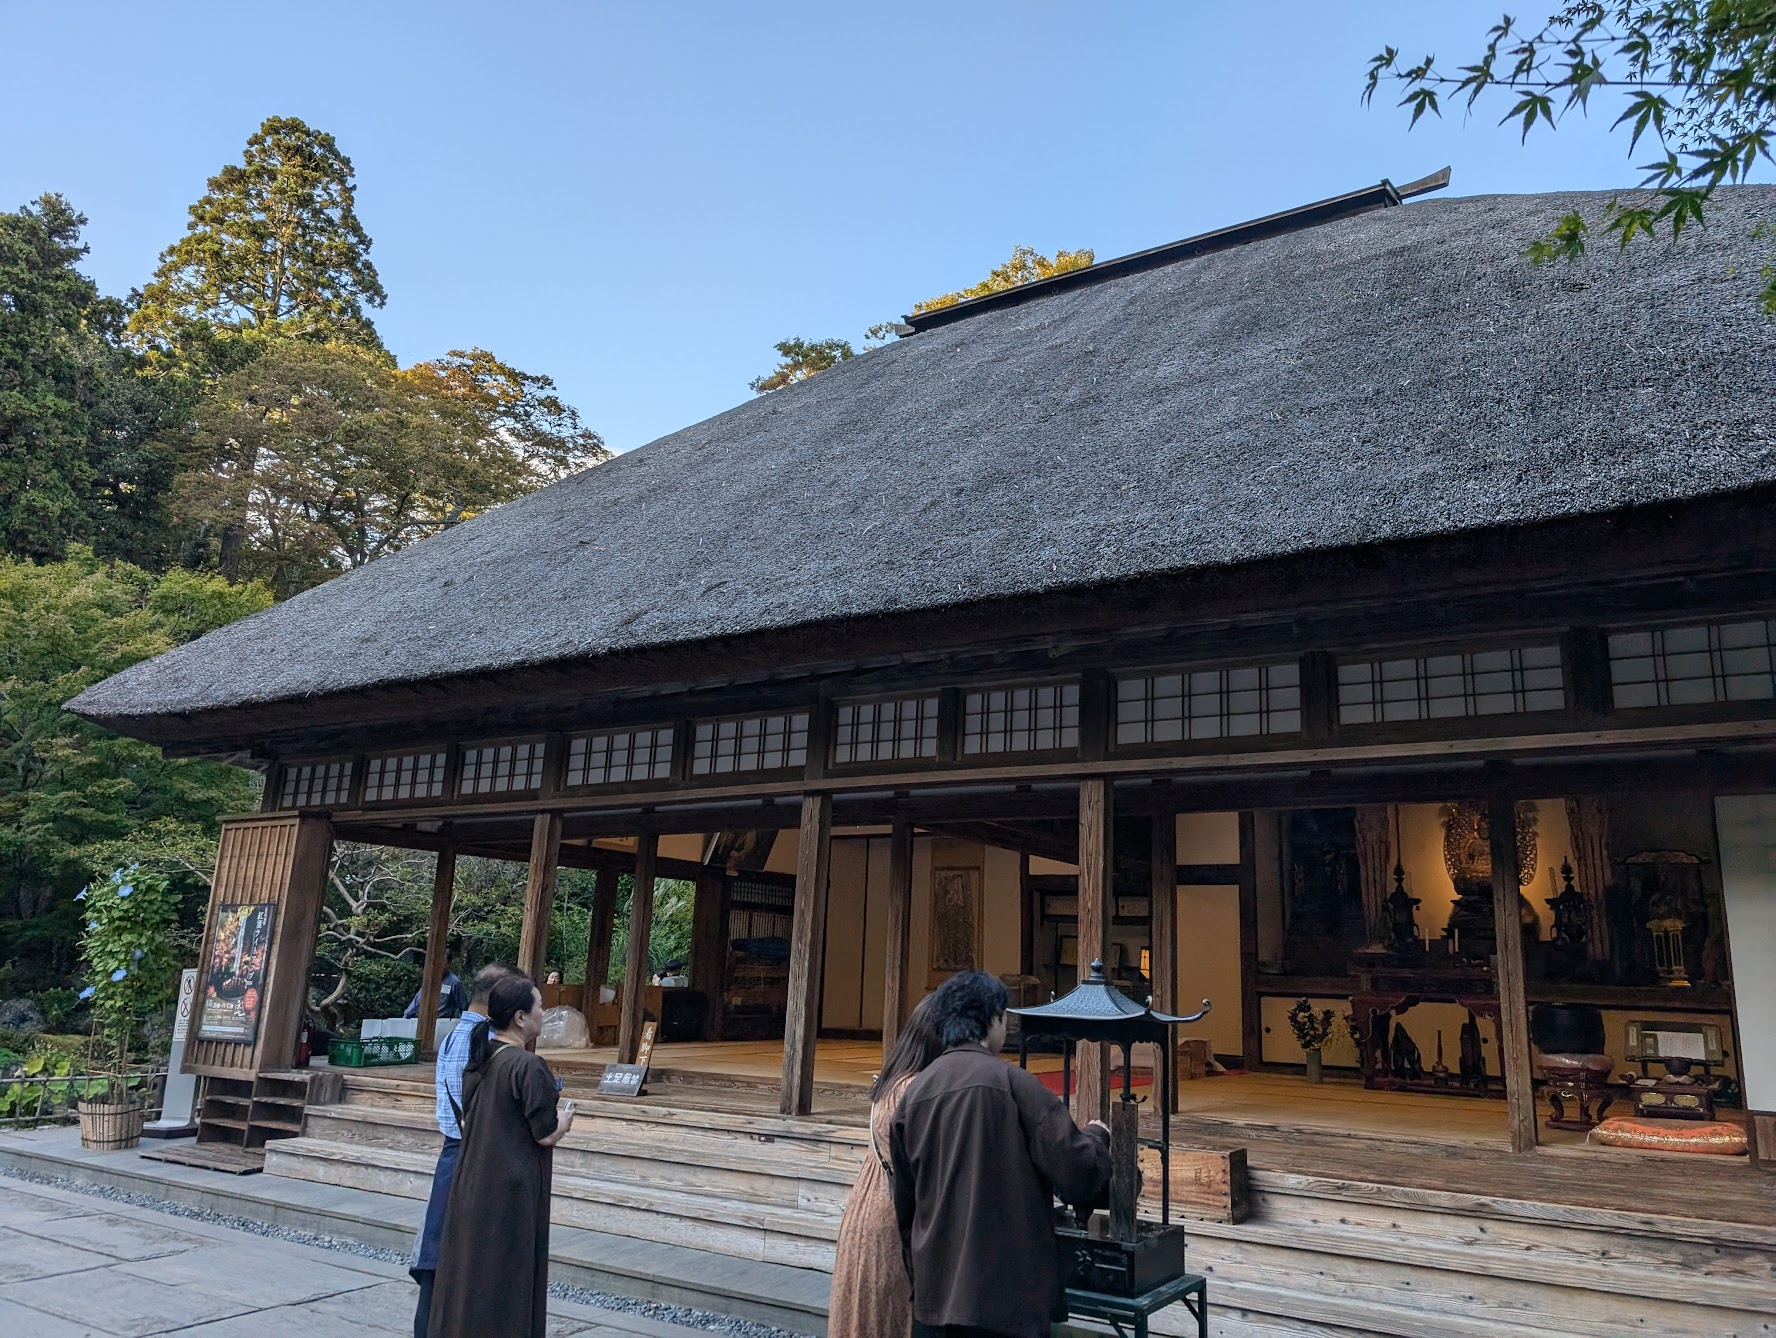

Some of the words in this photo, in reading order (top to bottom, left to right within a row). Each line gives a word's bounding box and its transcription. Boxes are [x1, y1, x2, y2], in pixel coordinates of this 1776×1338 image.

[639, 1027, 653, 1066] 看脚下
[603, 1072, 640, 1085] 土足厳禁
